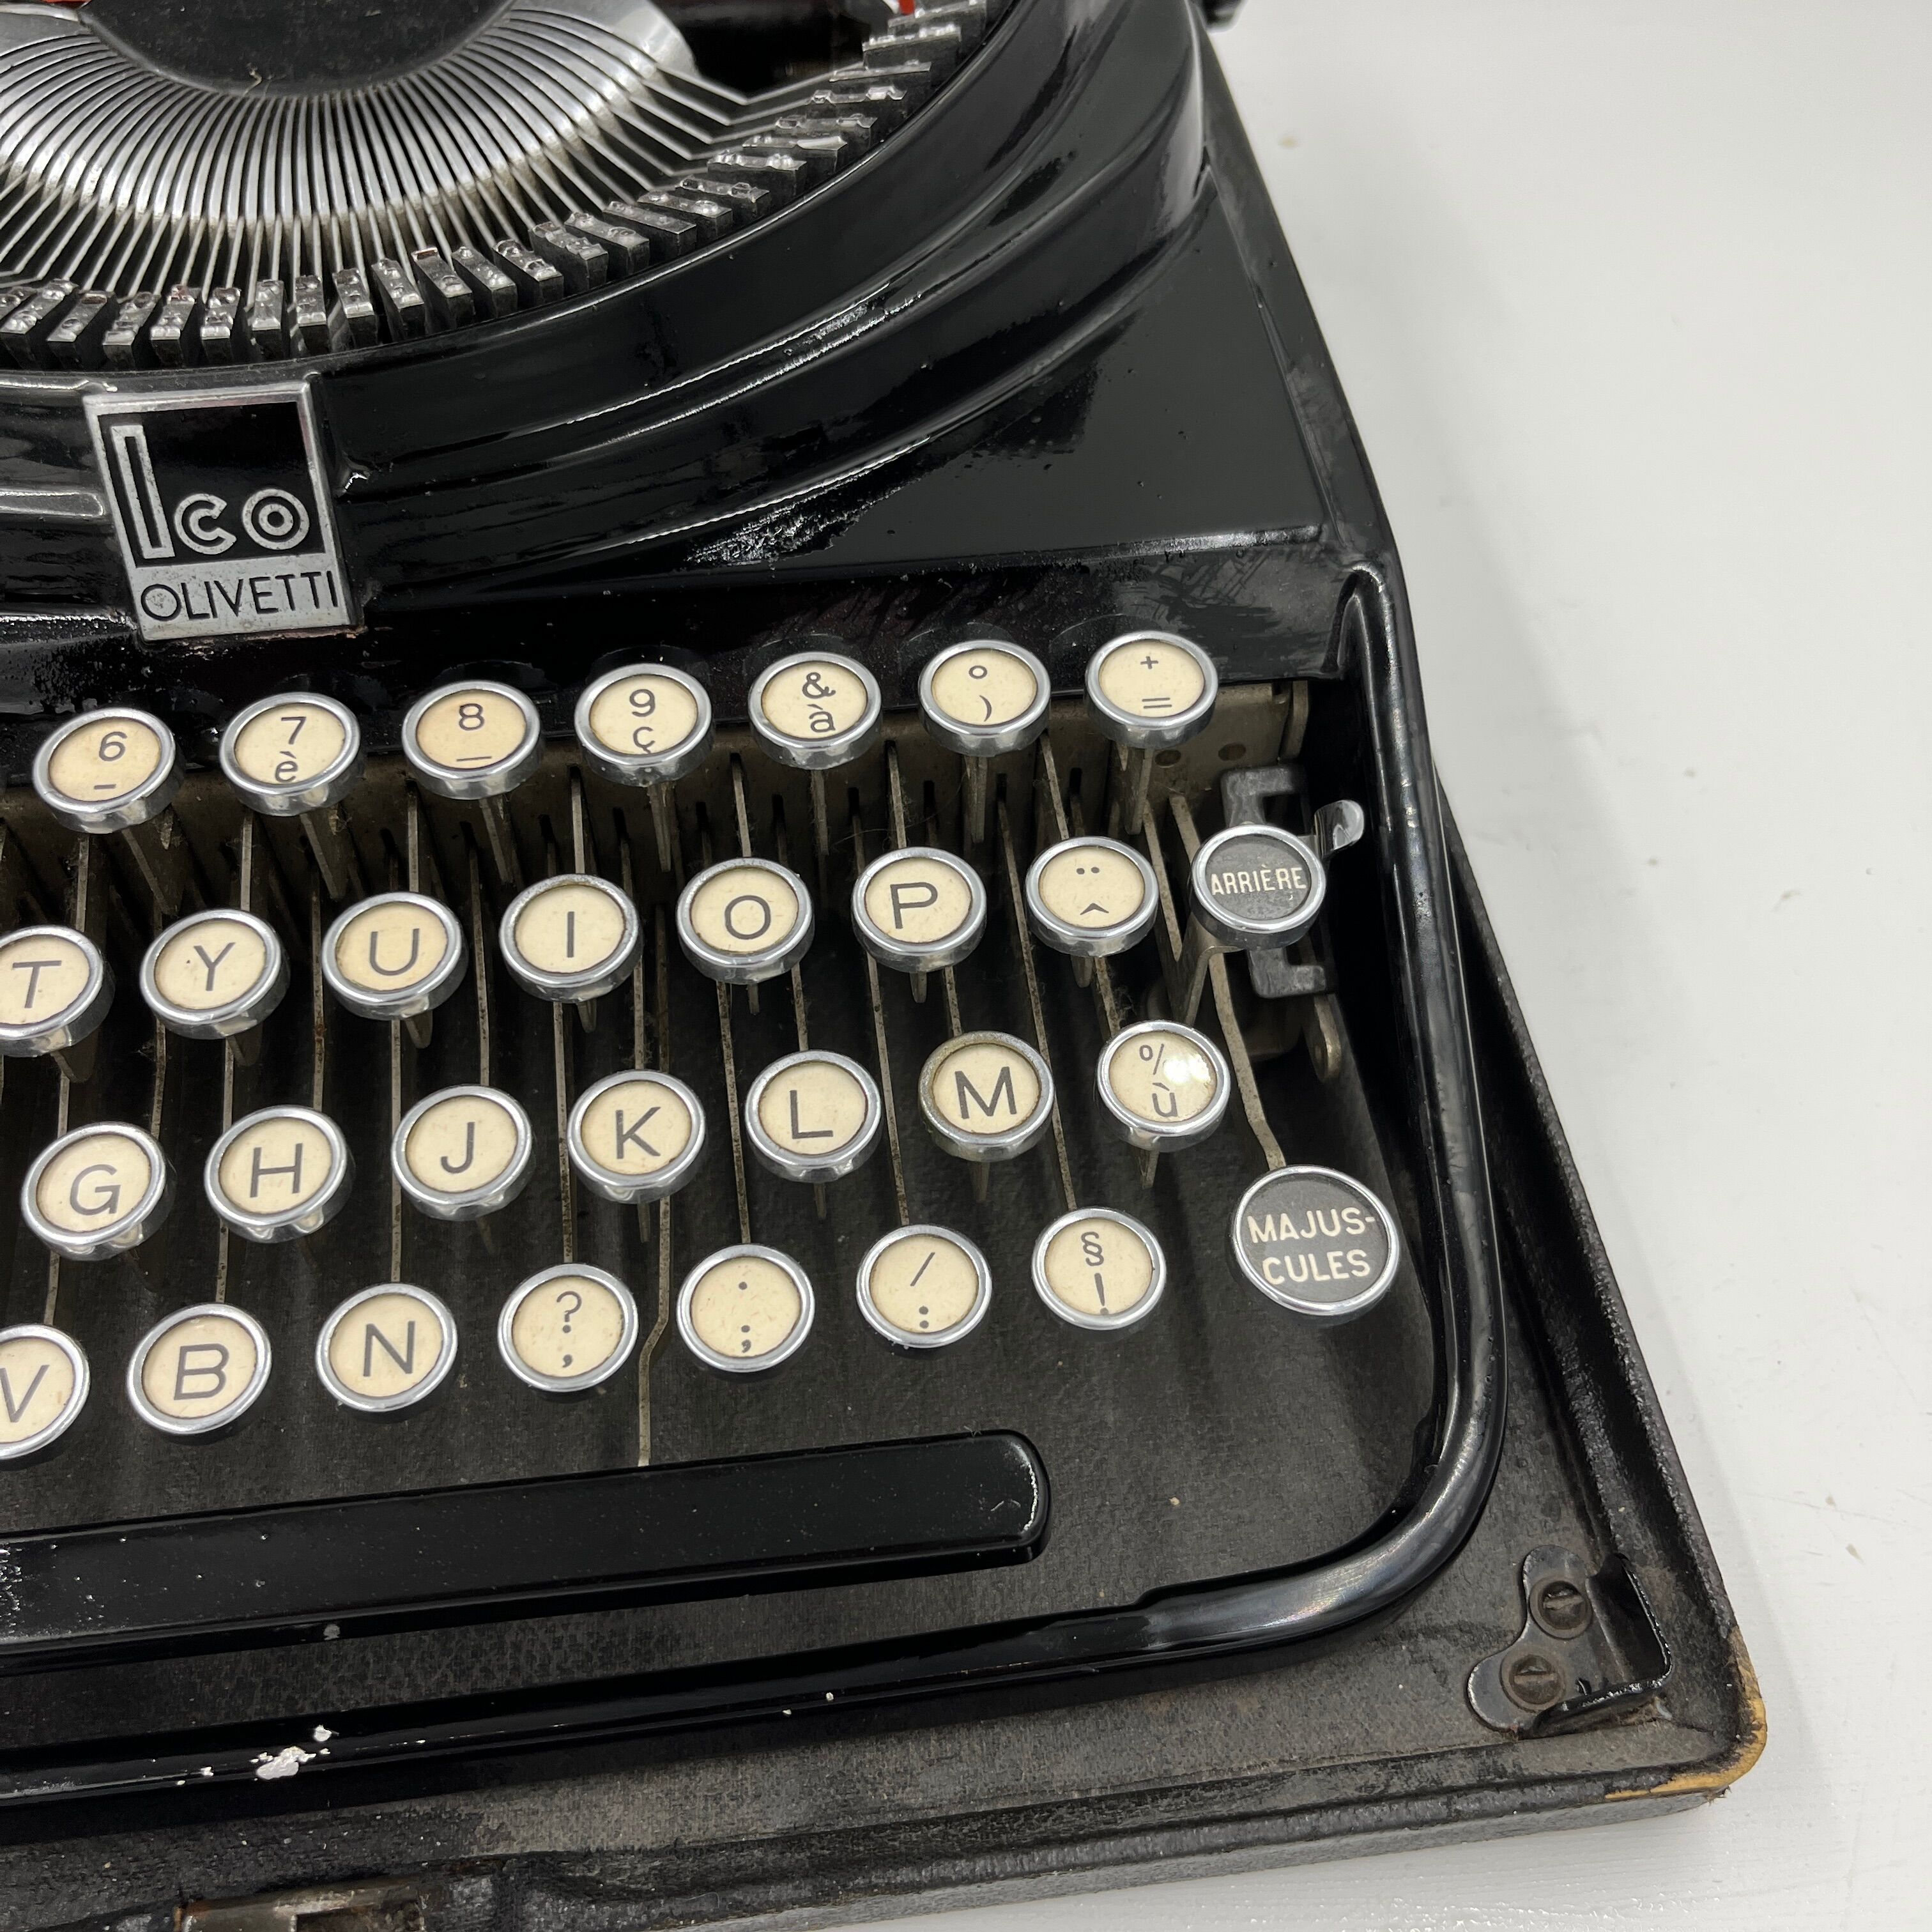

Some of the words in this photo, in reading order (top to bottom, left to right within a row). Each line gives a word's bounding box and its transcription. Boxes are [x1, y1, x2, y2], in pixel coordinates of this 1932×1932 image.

[140, 570, 339, 622] OLIVETTI
[1140, 656, 1159, 670] +
[629, 689, 656, 717] 9
[802, 671, 836, 700] &
[1141, 697, 1172, 709] =
[458, 703, 484, 731] 8
[806, 703, 836, 734] à
[979, 694, 993, 723] )
[98, 731, 128, 762] 6
[280, 716, 307, 745] 7
[632, 726, 656, 753] ç
[274, 750, 299, 783] è
[1210, 864, 1307, 896] ARRIÈRE
[724, 894, 771, 940] O
[889, 882, 939, 930] P
[369, 928, 420, 976] U
[566, 911, 575, 958] I
[12, 959, 63, 1009] T
[193, 942, 236, 992] Y
[954, 1066, 1017, 1120] M
[1152, 1082, 1179, 1118] ù
[615, 1107, 661, 1160] K
[789, 1089, 834, 1140] L
[440, 1121, 475, 1174] J
[250, 1142, 303, 1198] H
[69, 1163, 123, 1216] G
[1247, 1206, 1376, 1244] MAJUS-
[1080, 1231, 1105, 1267] §
[1261, 1248, 1371, 1286] CULES
[910, 1252, 935, 1287] /
[556, 1291, 582, 1333] ?
[918, 1305, 930, 1330] :
[362, 1321, 415, 1377] N
[740, 1324, 752, 1354] ;
[173, 1343, 229, 1400] B
[0, 1363, 50, 1423] V
